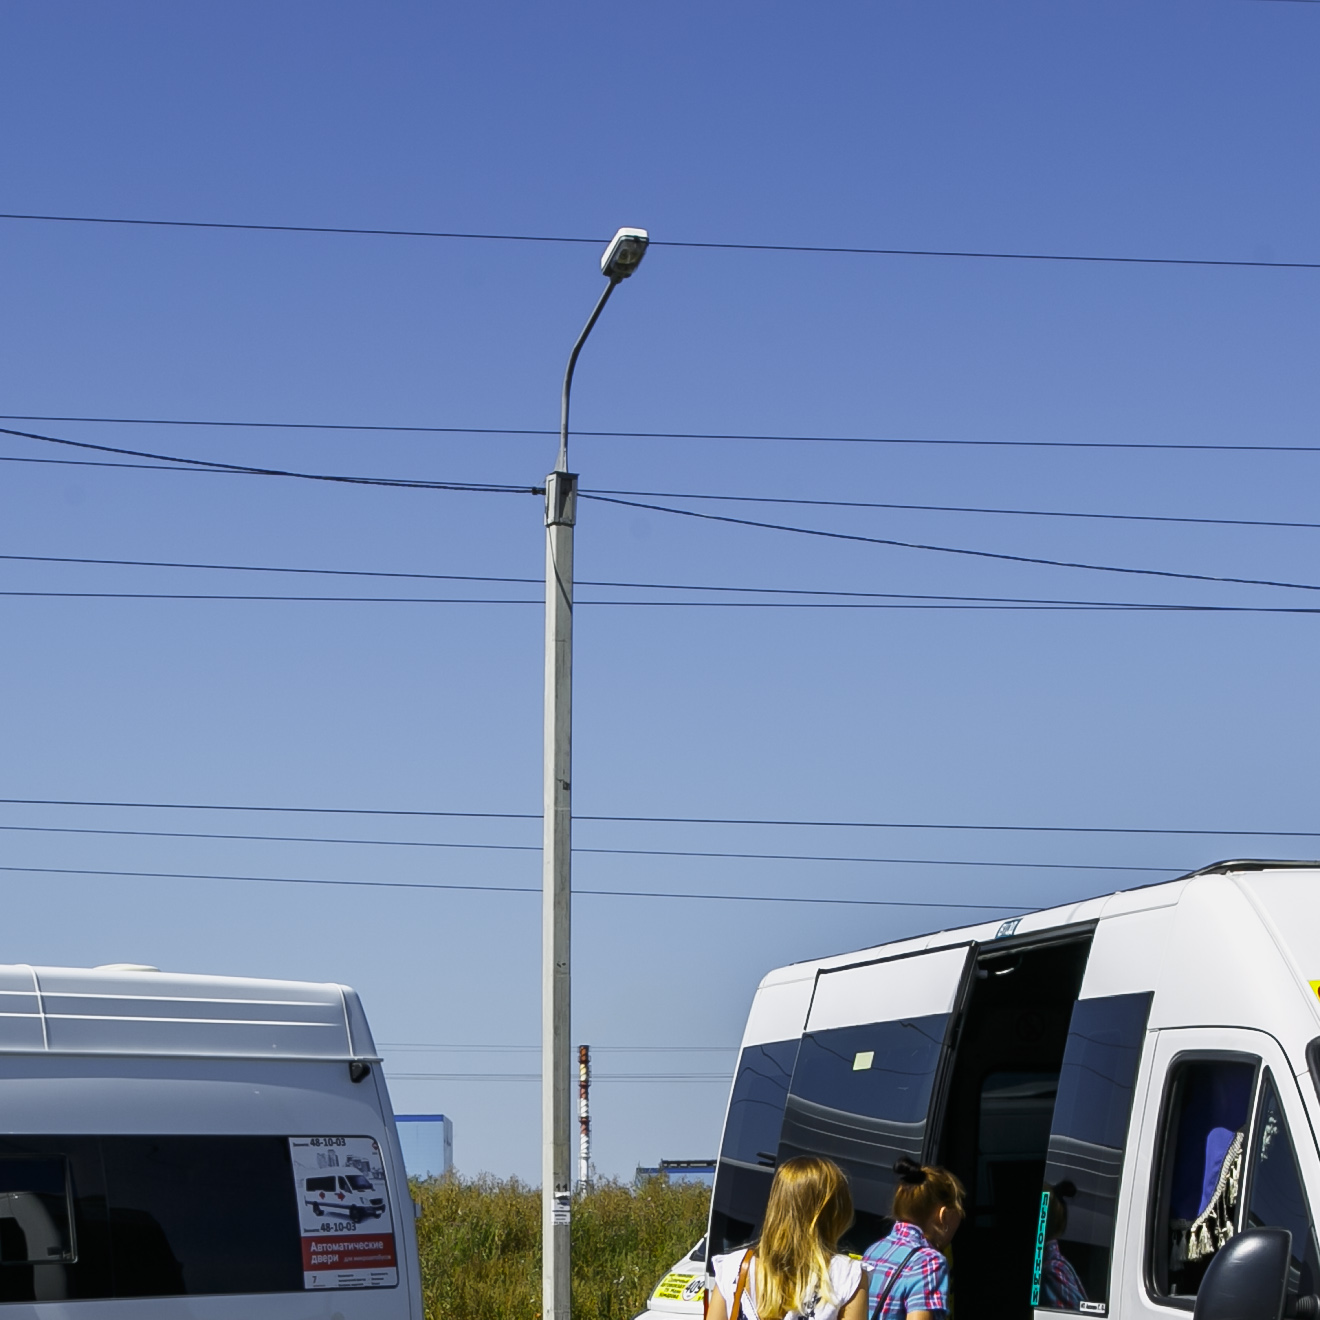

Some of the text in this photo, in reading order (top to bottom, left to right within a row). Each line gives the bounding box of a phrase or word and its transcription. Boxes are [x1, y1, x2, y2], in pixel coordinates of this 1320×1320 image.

[310, 1137, 347, 1147] 48-10-03
[320, 1221, 357, 1232] 48-10-03
[310, 1240, 384, 1252] Автоматические
[310, 1254, 339, 1265] двери
